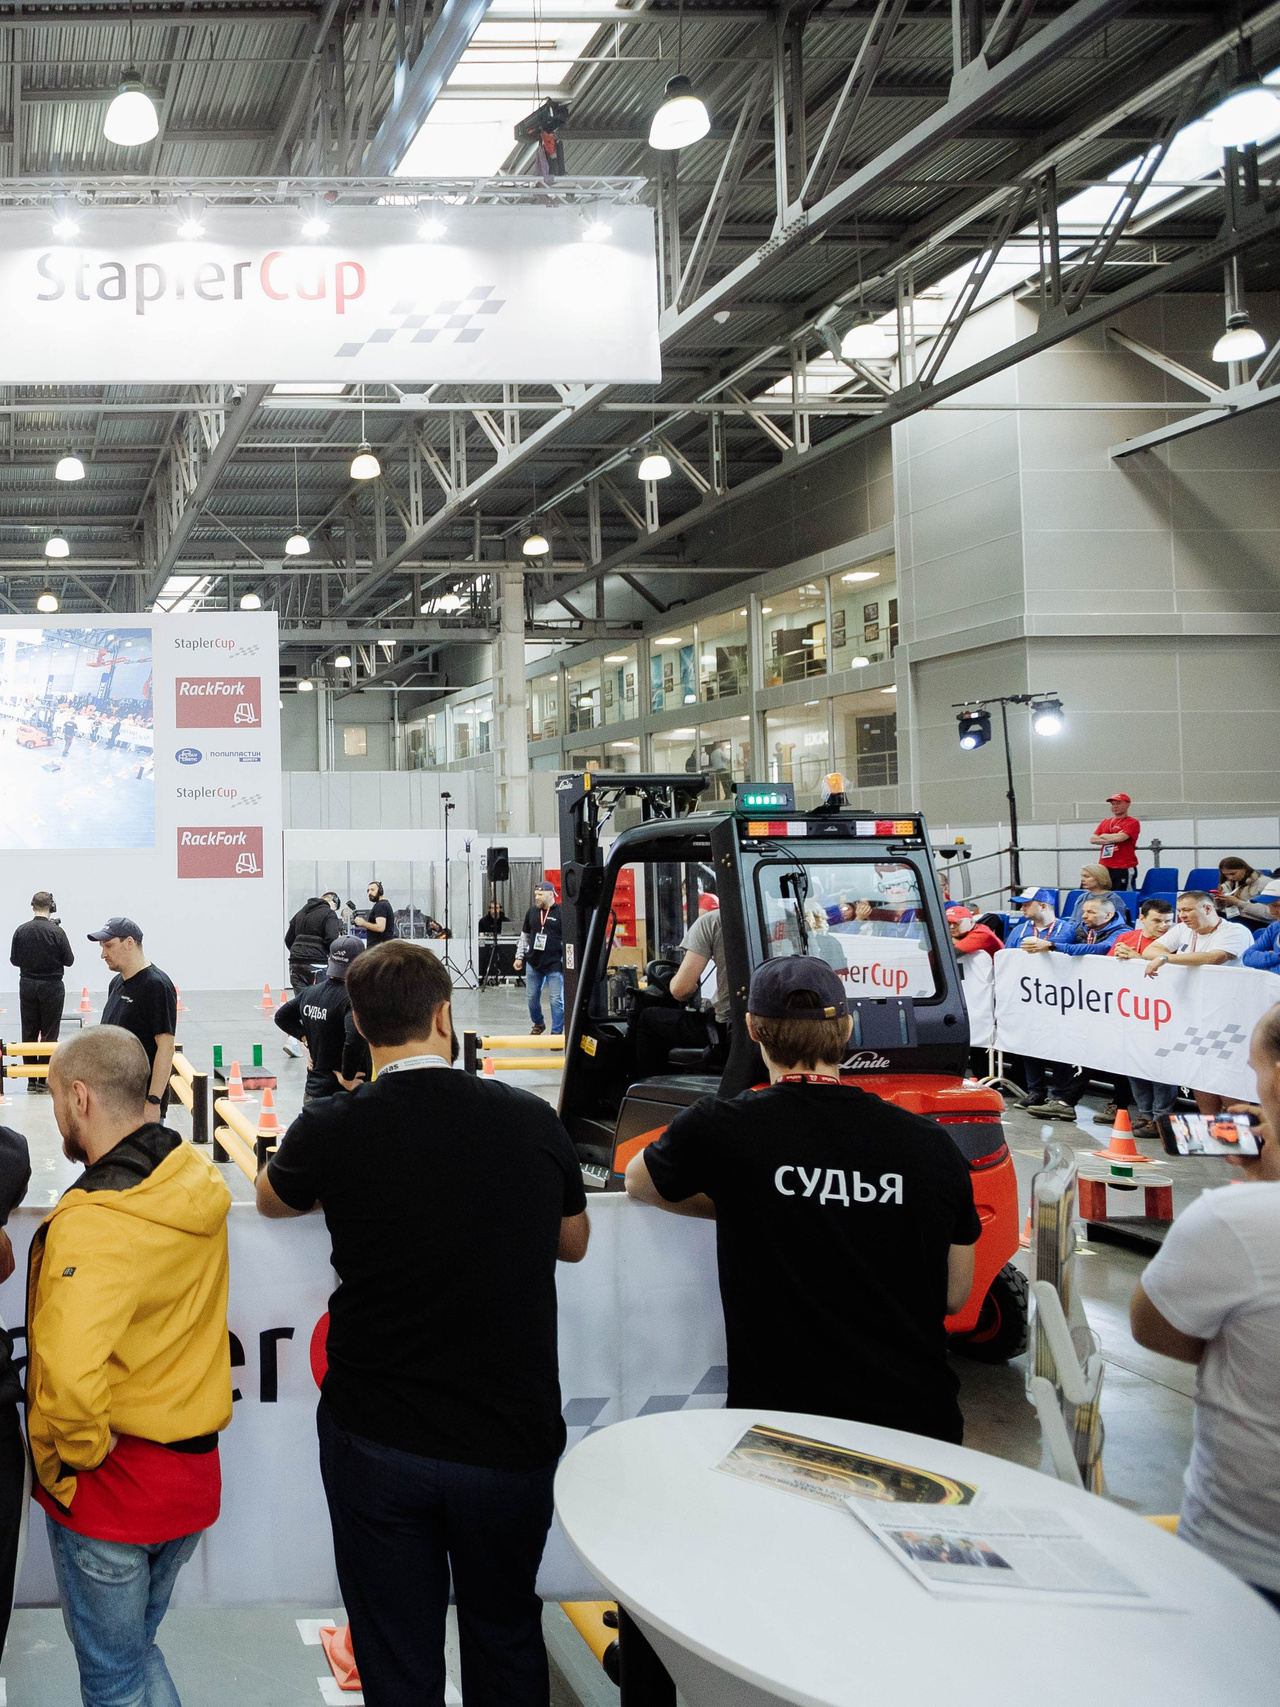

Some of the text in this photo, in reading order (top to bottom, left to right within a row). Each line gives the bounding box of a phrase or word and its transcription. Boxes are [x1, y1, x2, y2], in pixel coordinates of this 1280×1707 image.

[174, 638, 235, 650] StaplerCup
[179, 681, 245, 696] RackFork
[176, 787, 237, 800] StaplerCup
[181, 831, 247, 846] RackFork
[843, 963, 908, 995] erCup
[1020, 976, 1172, 1031] StaplerCup
[303, 1004, 327, 1022] СУДЬЯ
[837, 1051, 890, 1069] Linde
[774, 1165, 904, 1206] СУДЬЯ
